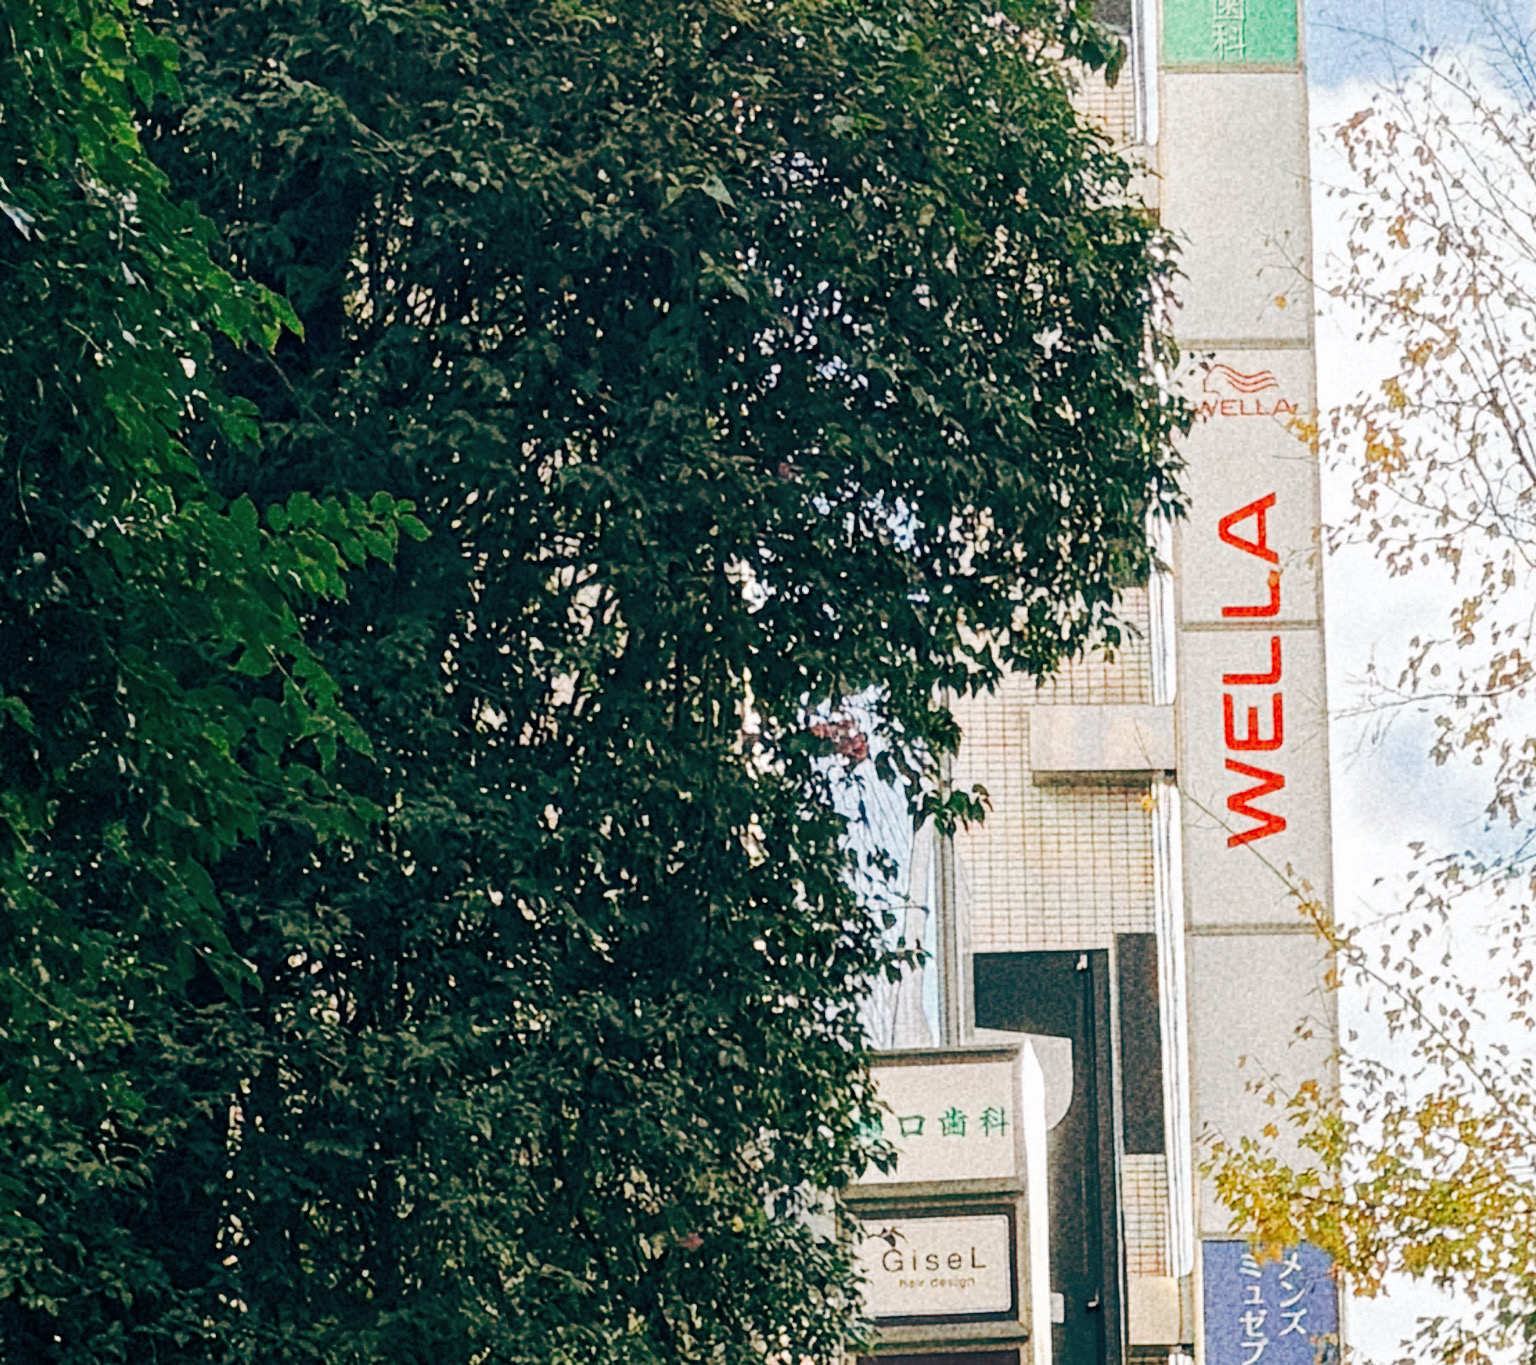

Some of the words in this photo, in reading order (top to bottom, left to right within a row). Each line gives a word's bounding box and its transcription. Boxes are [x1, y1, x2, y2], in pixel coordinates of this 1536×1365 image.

[1218, 492, 1286, 849] WELLA
[856, 1106, 1009, 1139] 口歯科
[882, 1246, 987, 1273] GiseL
[1278, 1252, 1308, 1337] メンズ
